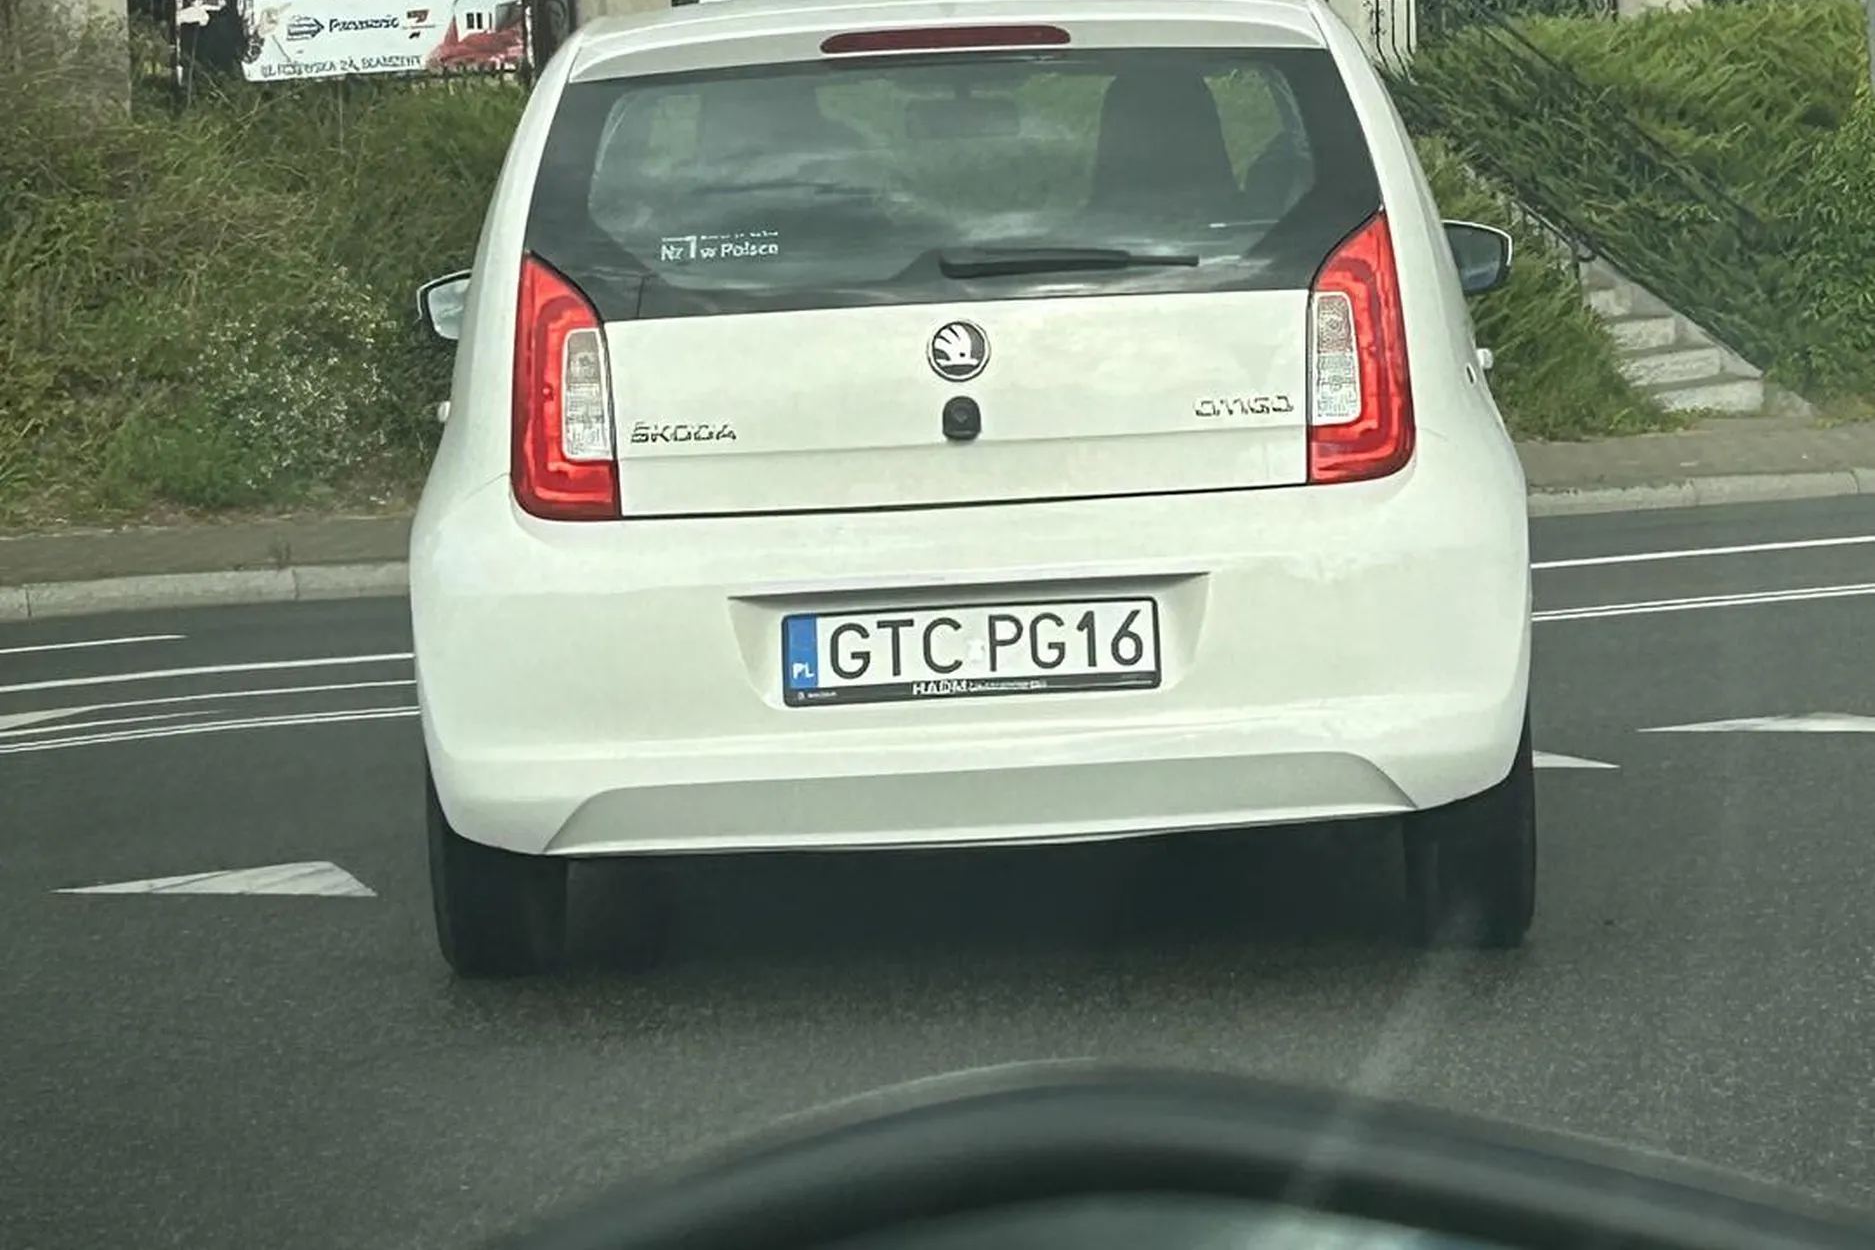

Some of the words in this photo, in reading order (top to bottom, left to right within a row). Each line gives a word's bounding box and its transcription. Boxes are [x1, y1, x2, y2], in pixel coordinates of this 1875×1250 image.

[829, 616, 963, 680] GTC
[987, 609, 1144, 672] PG16
[792, 661, 815, 680] PL
